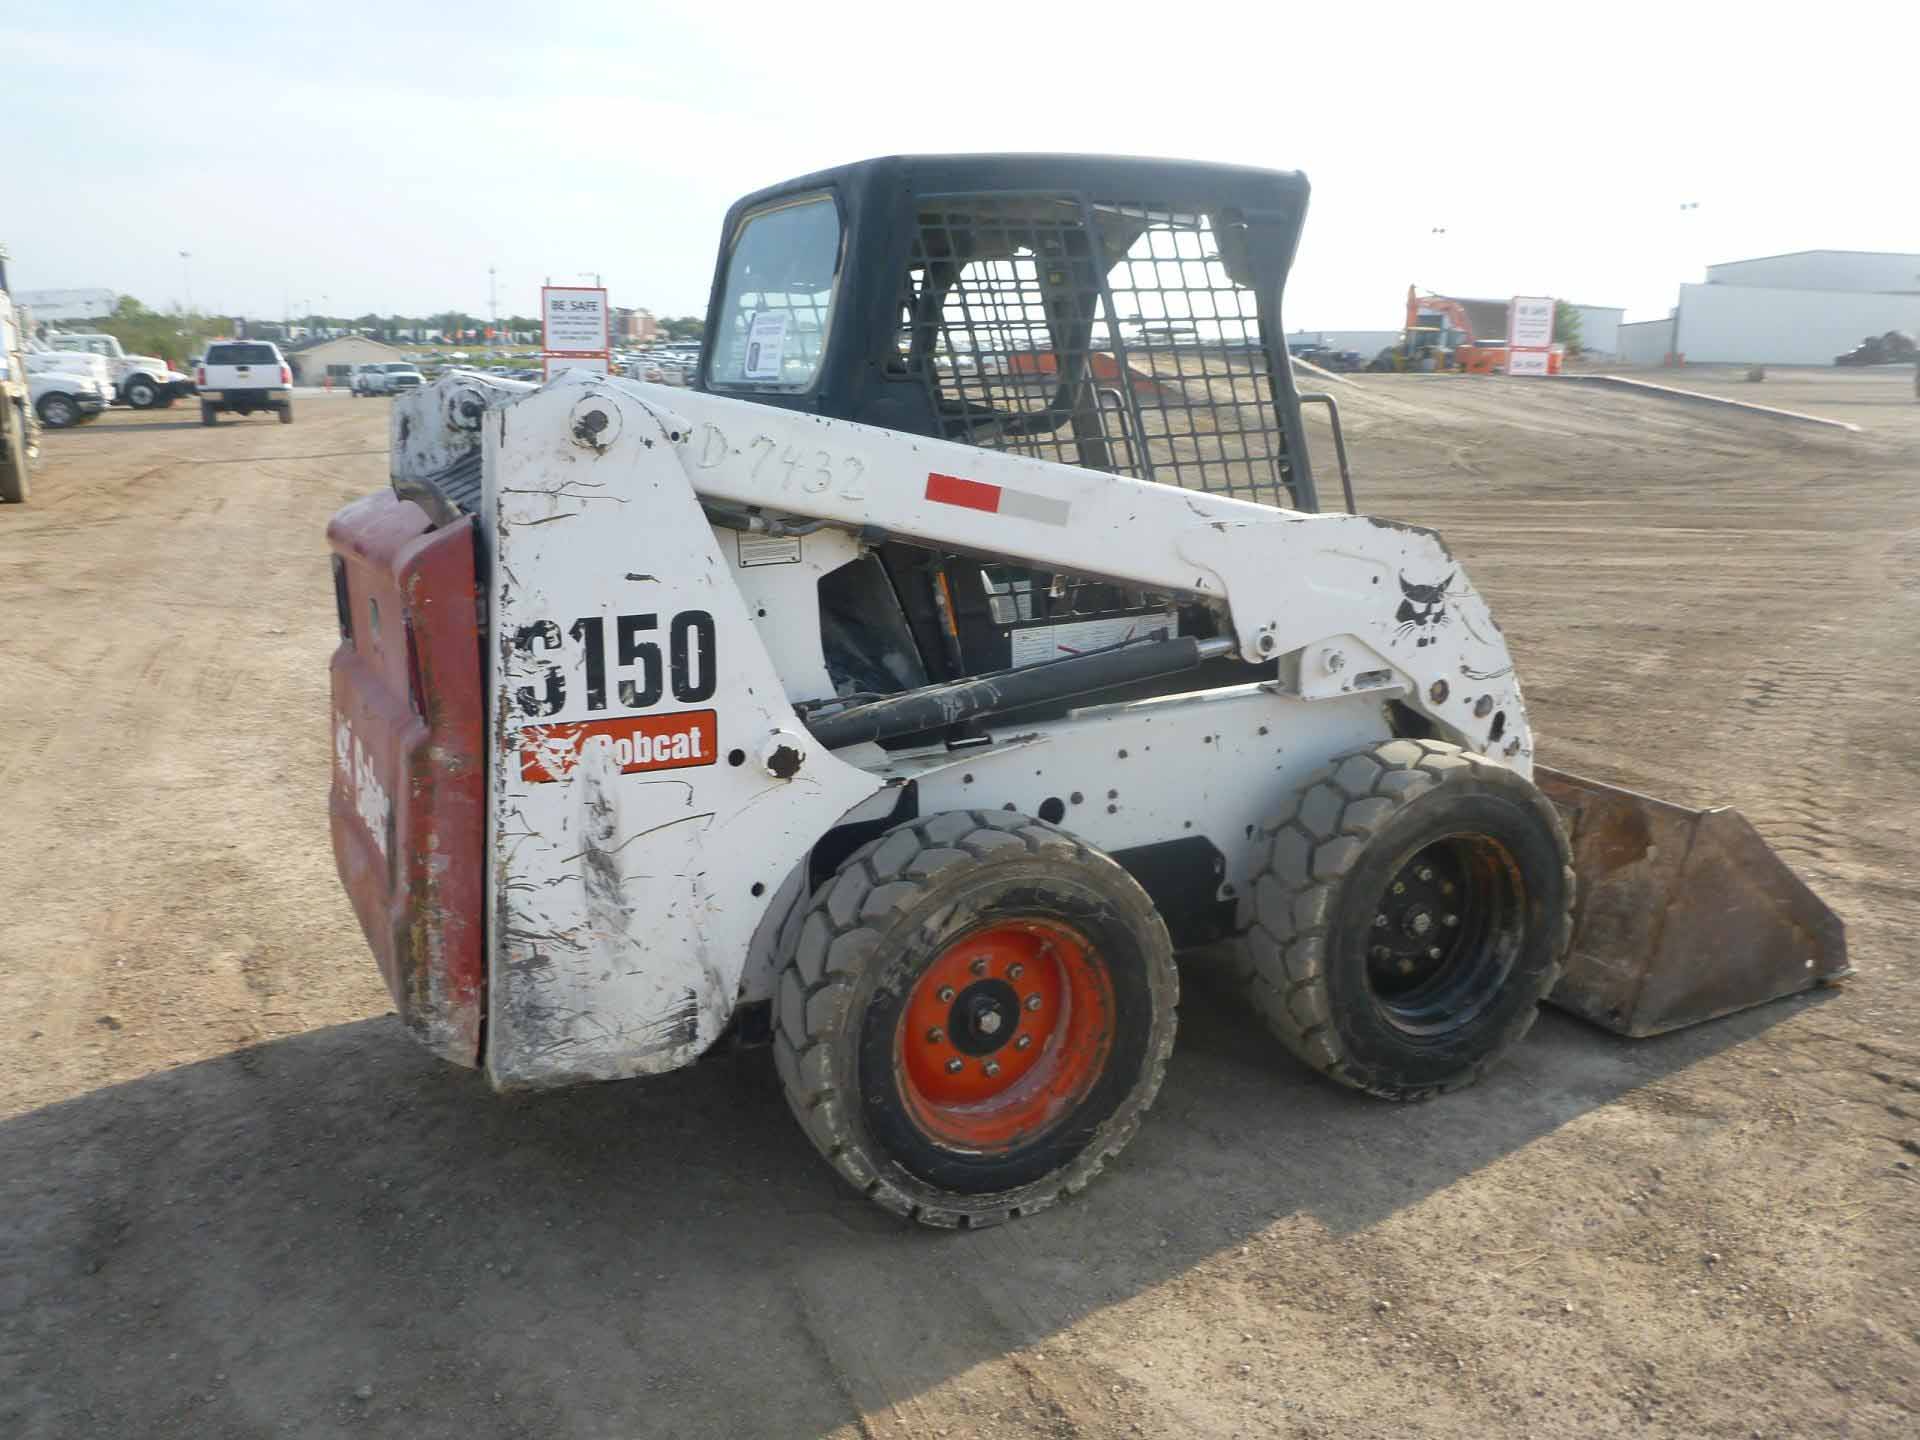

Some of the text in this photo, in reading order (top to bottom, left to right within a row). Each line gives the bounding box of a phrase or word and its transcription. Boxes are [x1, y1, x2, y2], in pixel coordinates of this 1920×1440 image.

[551, 300, 599, 312] BE SAFE
[514, 610, 717, 717] S150
